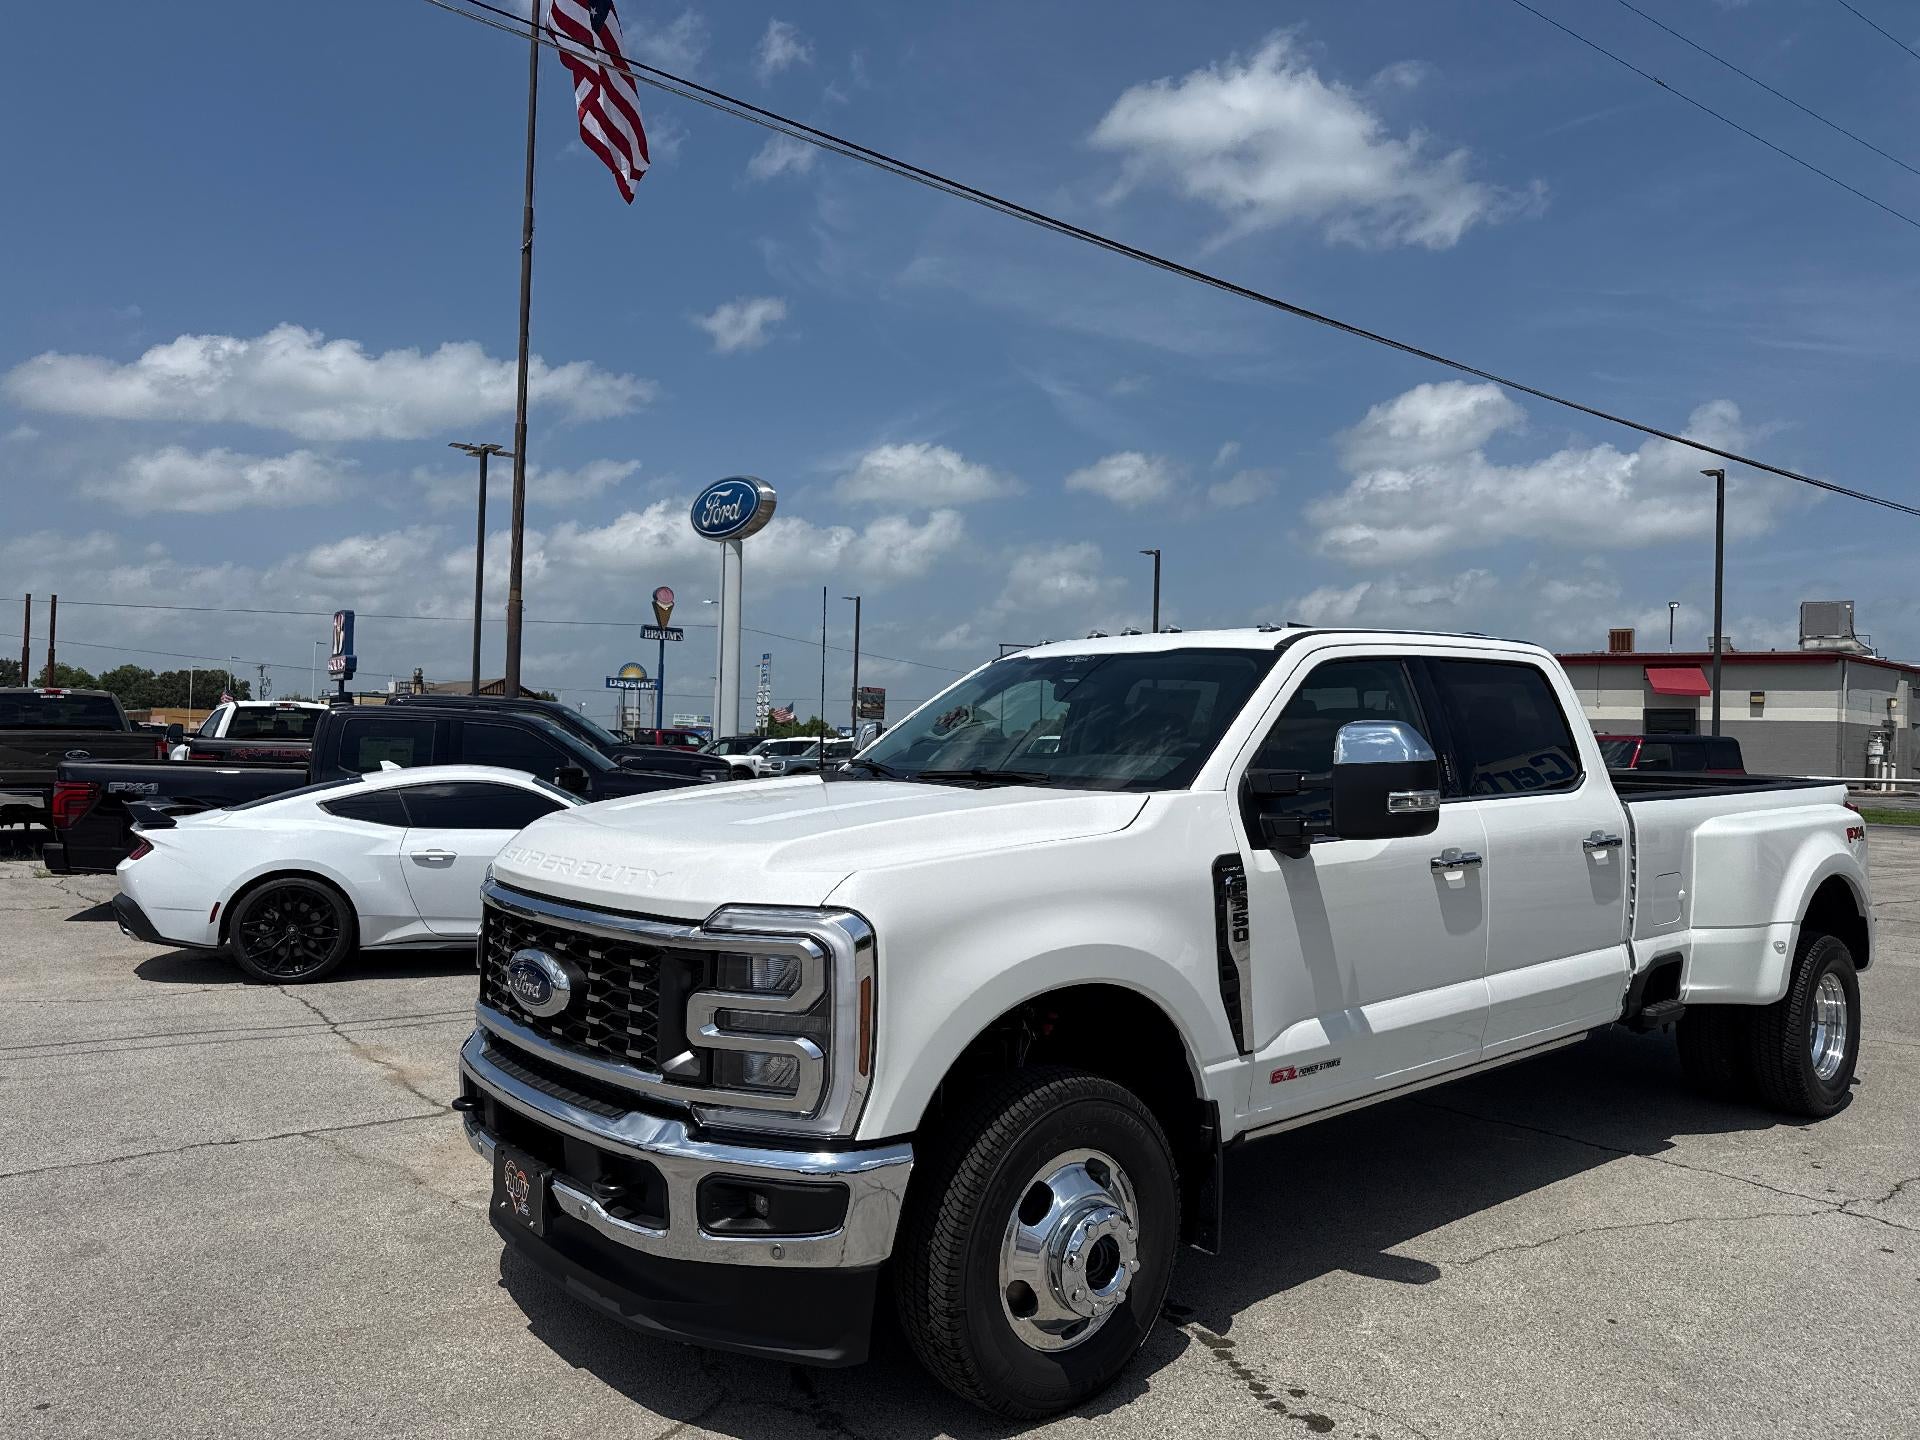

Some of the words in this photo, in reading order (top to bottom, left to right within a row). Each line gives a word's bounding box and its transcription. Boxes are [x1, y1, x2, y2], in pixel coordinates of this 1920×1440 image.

[702, 489, 743, 528] Ford
[643, 629, 683, 641] BRAUM'S
[609, 679, 636, 689] Days
[108, 781, 159, 795] FX4
[503, 846, 577, 875] SUPER
[577, 860, 673, 888] DUTY
[515, 969, 542, 998] Ford
